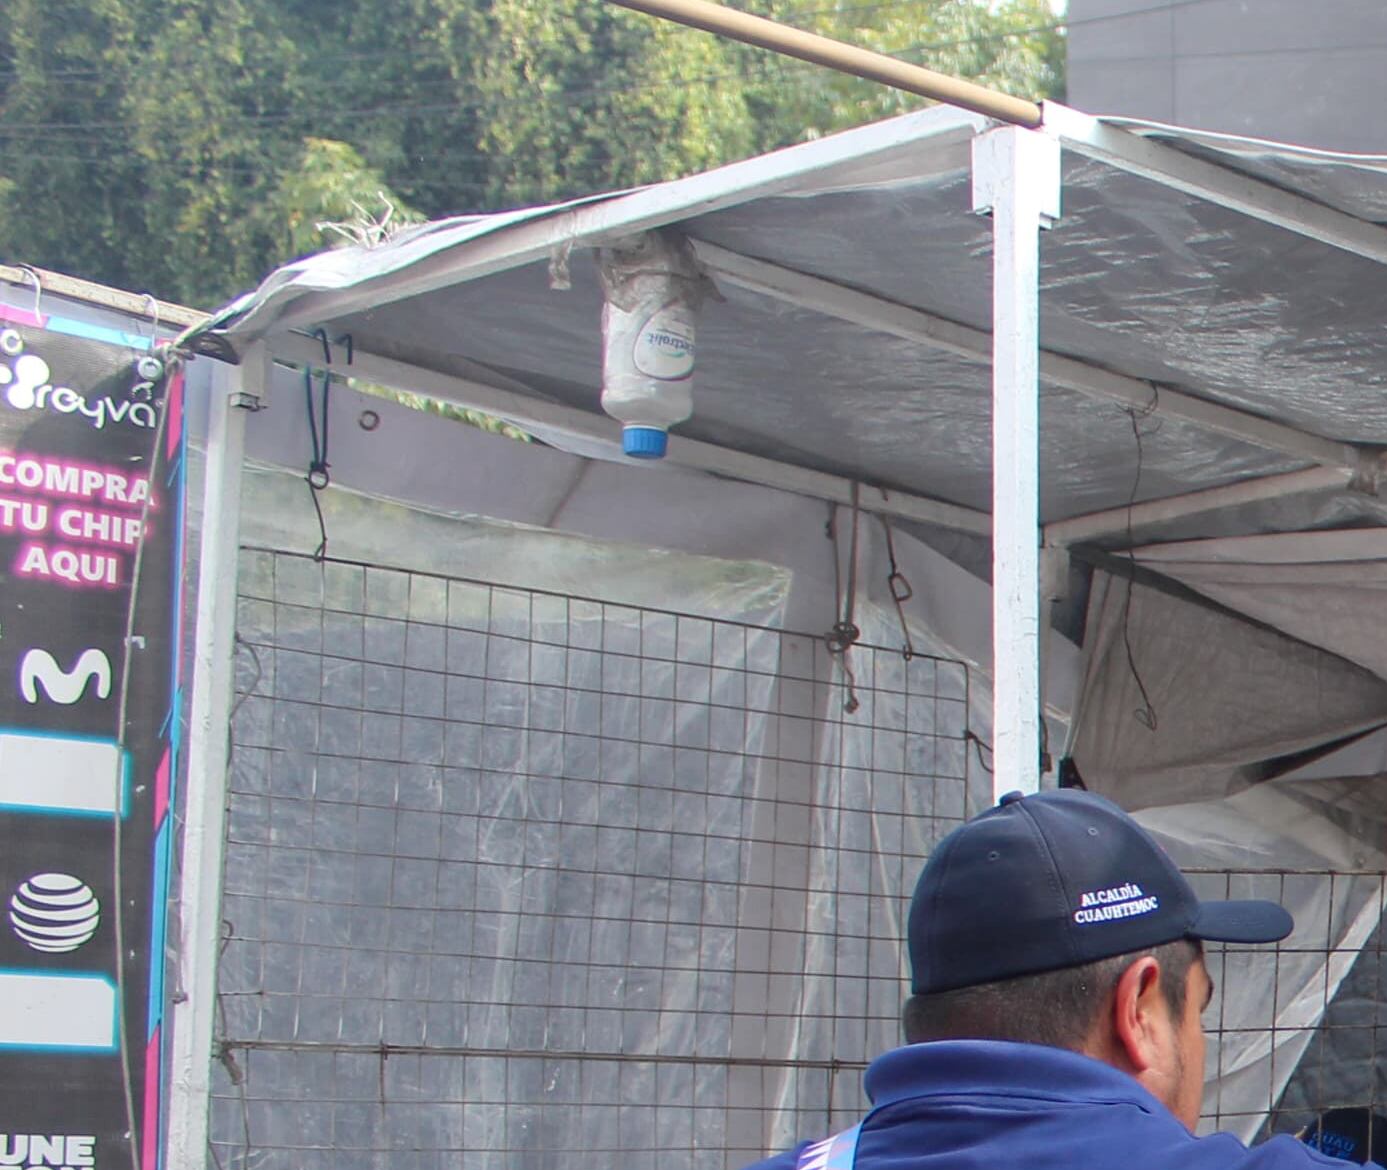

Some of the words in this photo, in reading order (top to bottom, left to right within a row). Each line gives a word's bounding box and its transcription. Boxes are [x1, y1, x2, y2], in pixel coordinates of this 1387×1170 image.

[0, 456, 155, 506] COMPRA
[0, 500, 48, 531] TU
[60, 509, 148, 545] CHIP
[22, 547, 118, 584] AQUI
[1074, 896, 1159, 923] CUAUHTEMOC
[1081, 882, 1143, 907] ALCALDÍA
[0, 1134, 97, 1166] UNE
